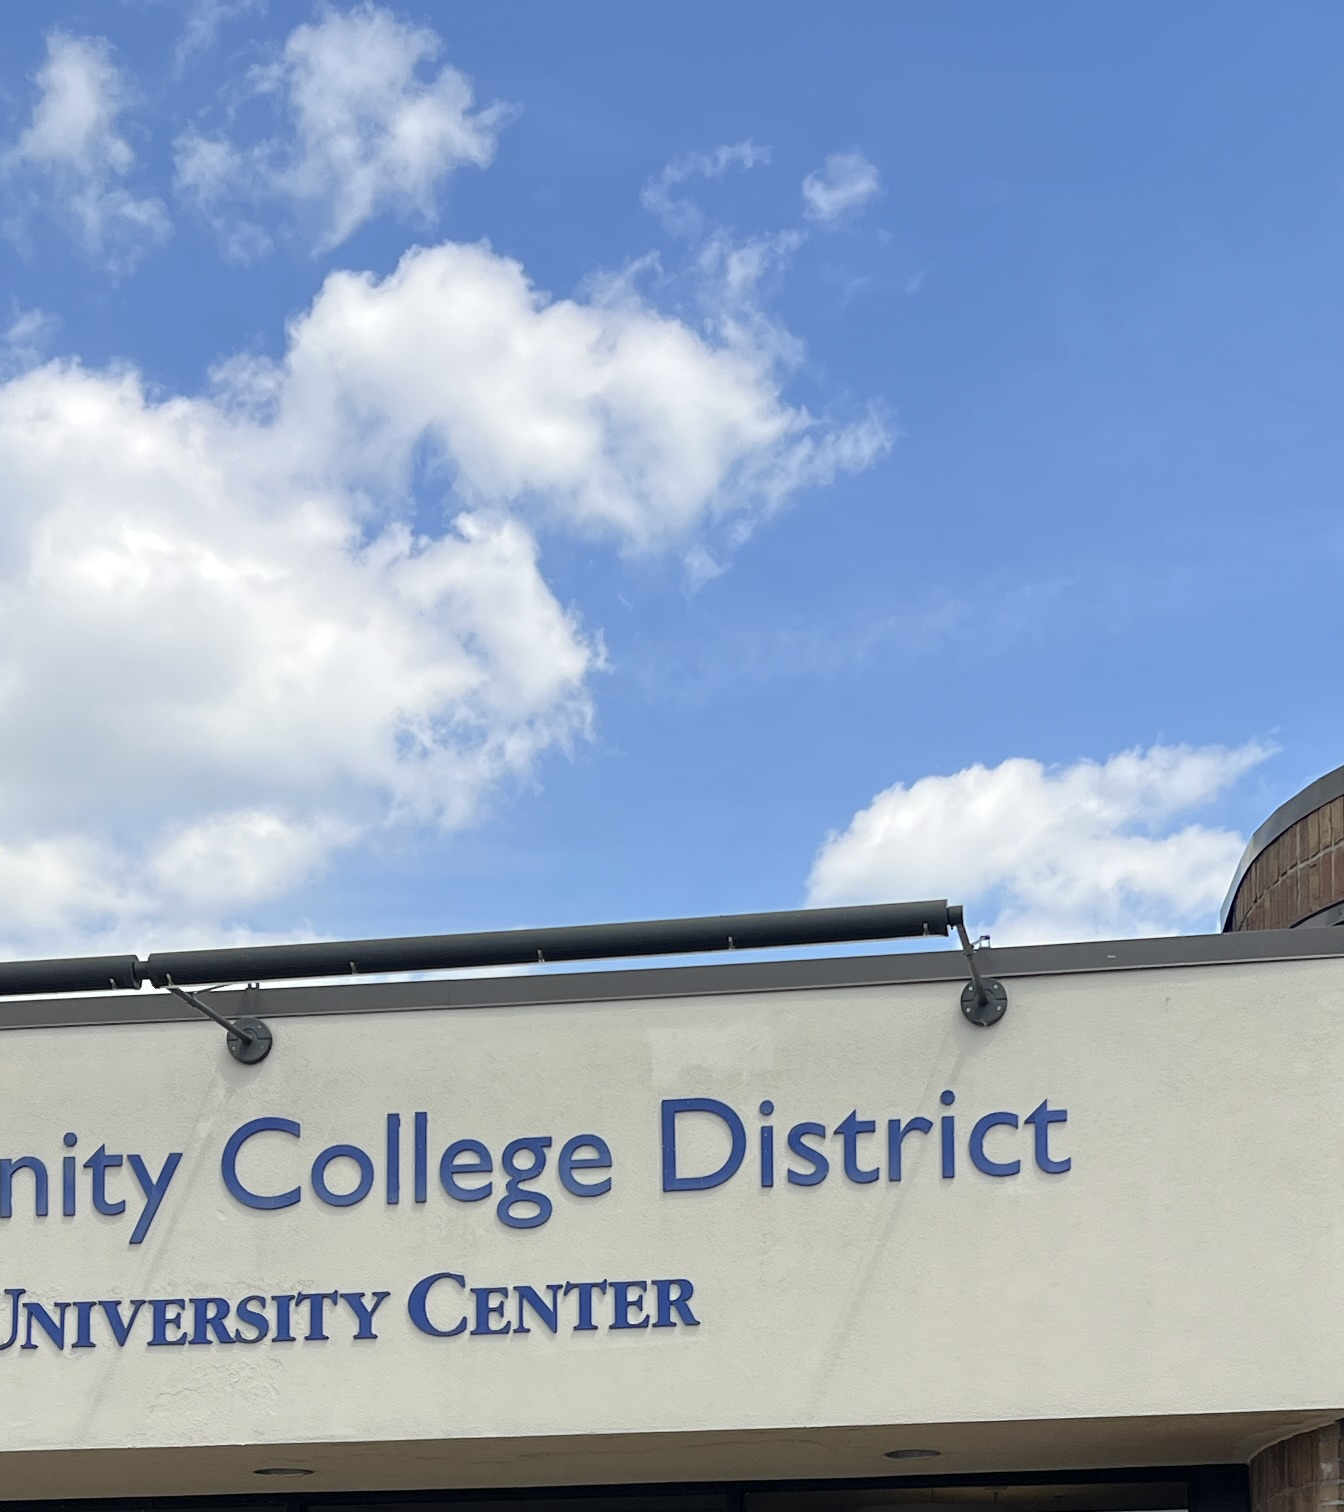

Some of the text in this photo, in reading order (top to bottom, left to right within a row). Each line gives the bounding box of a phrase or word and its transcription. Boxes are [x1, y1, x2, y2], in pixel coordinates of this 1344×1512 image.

[221, 1111, 613, 1230] College
[661, 1090, 1072, 1193] District
[406, 1272, 701, 1338] CENTER
